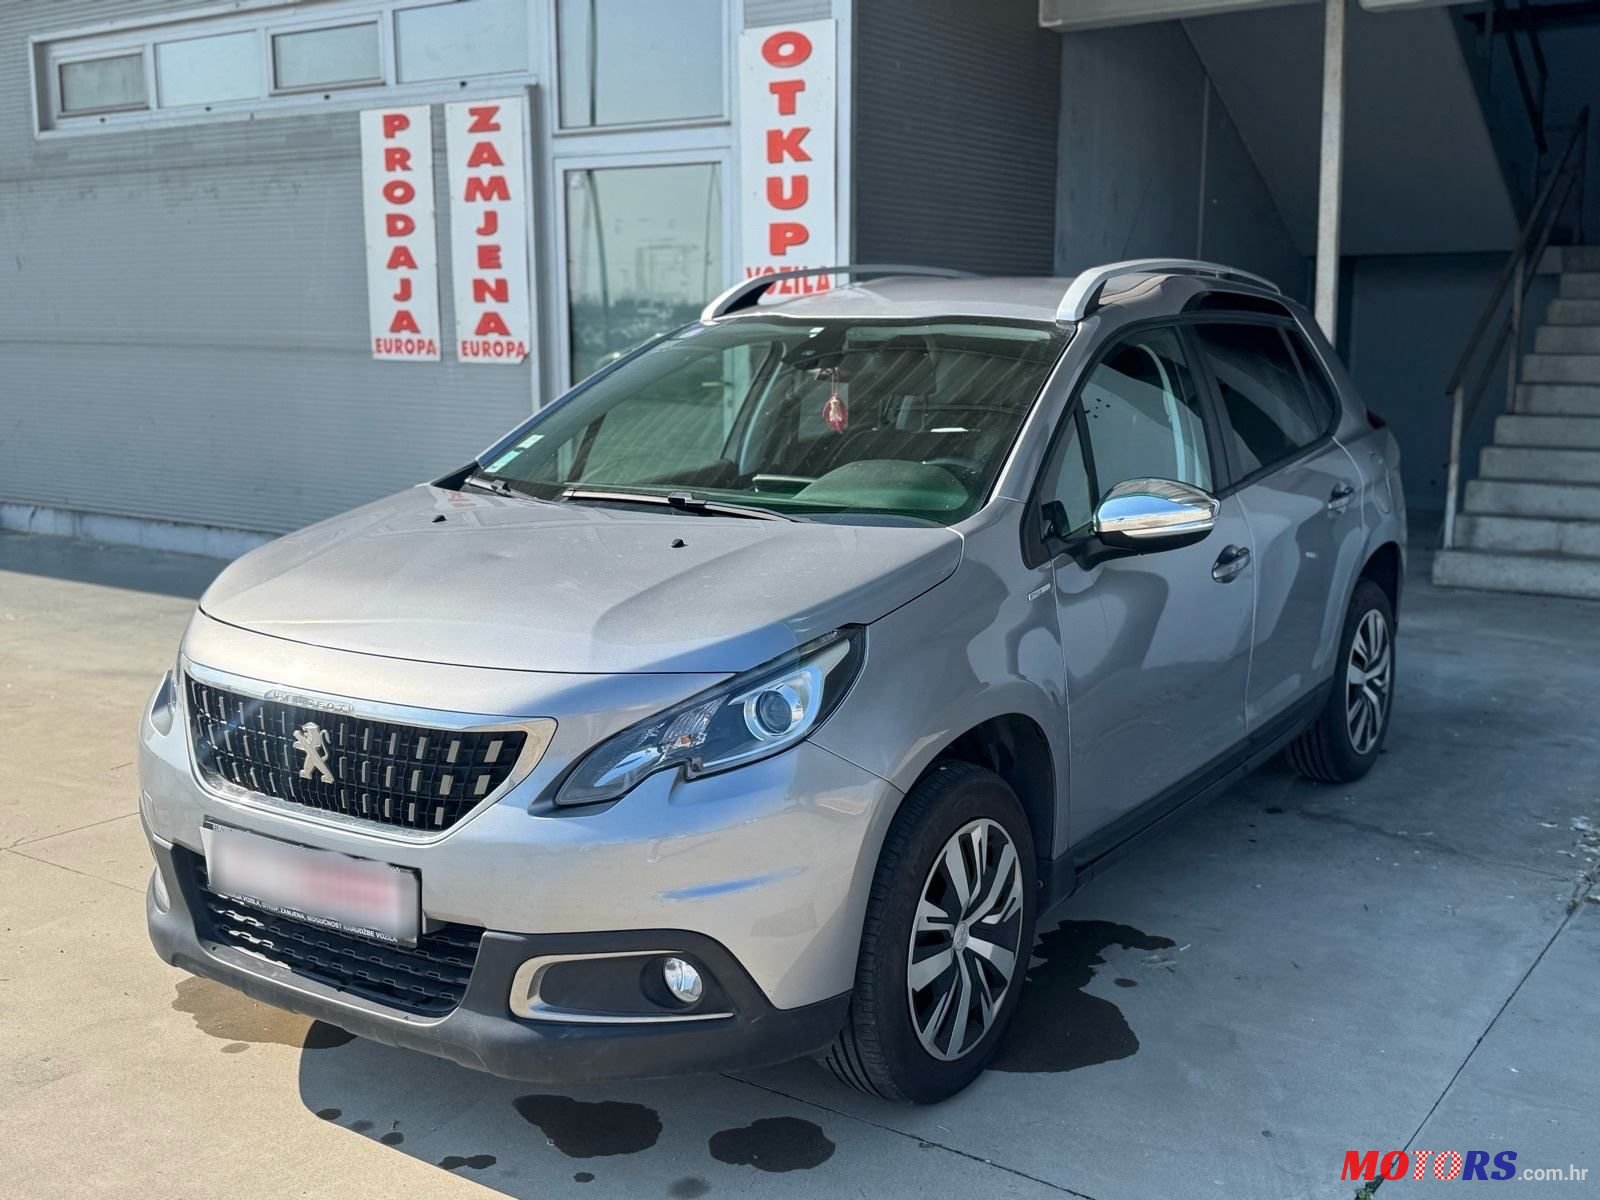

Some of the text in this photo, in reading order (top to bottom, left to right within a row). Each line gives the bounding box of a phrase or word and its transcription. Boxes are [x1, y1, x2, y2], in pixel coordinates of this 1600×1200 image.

[383, 114, 421, 334] PRODAJA
[464, 107, 511, 336] ZAMJENA
[761, 31, 812, 256] OTKUP
[375, 338, 437, 355] EUROPA
[461, 340, 525, 357] EUROPA
